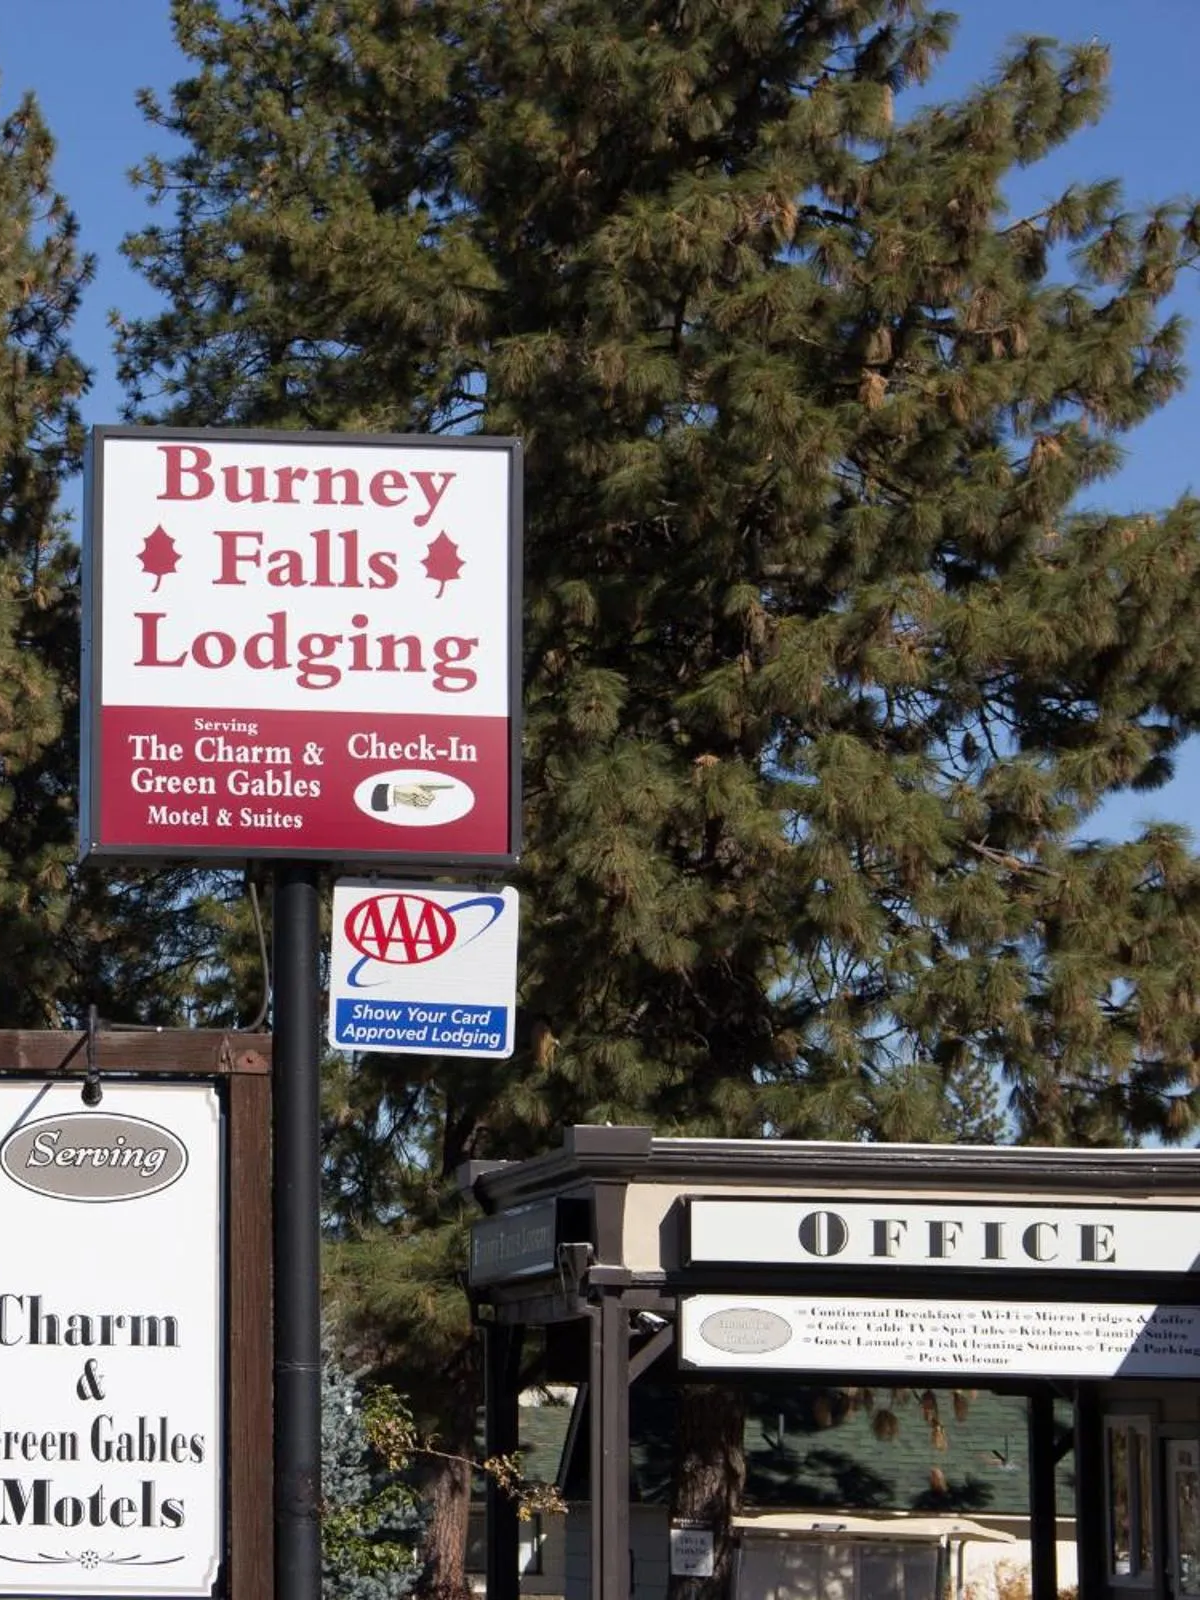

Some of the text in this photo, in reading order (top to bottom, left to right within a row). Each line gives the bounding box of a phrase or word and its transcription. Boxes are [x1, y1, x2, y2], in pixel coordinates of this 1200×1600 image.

[156, 445, 457, 528] Burney
[212, 529, 398, 590] Falls
[133, 611, 479, 693] Lodging
[194, 718, 258, 735] Serving
[128, 735, 324, 766] The Charm &
[348, 733, 478, 762] Check-In
[131, 767, 321, 798] Green Gables
[148, 806, 303, 829] Motel & Suites
[354, 894, 446, 963] AAA
[352, 1004, 491, 1025] Show Your Card
[342, 1023, 501, 1048] Approved Lodging
[25, 1129, 168, 1178] Serving
[798, 1210, 1116, 1263] OFFICE
[811, 1307, 888, 1318] Continental
[895, 1308, 962, 1319] Breakfast
[76, 1358, 106, 1400] &
[90, 1413, 205, 1463] Gables
